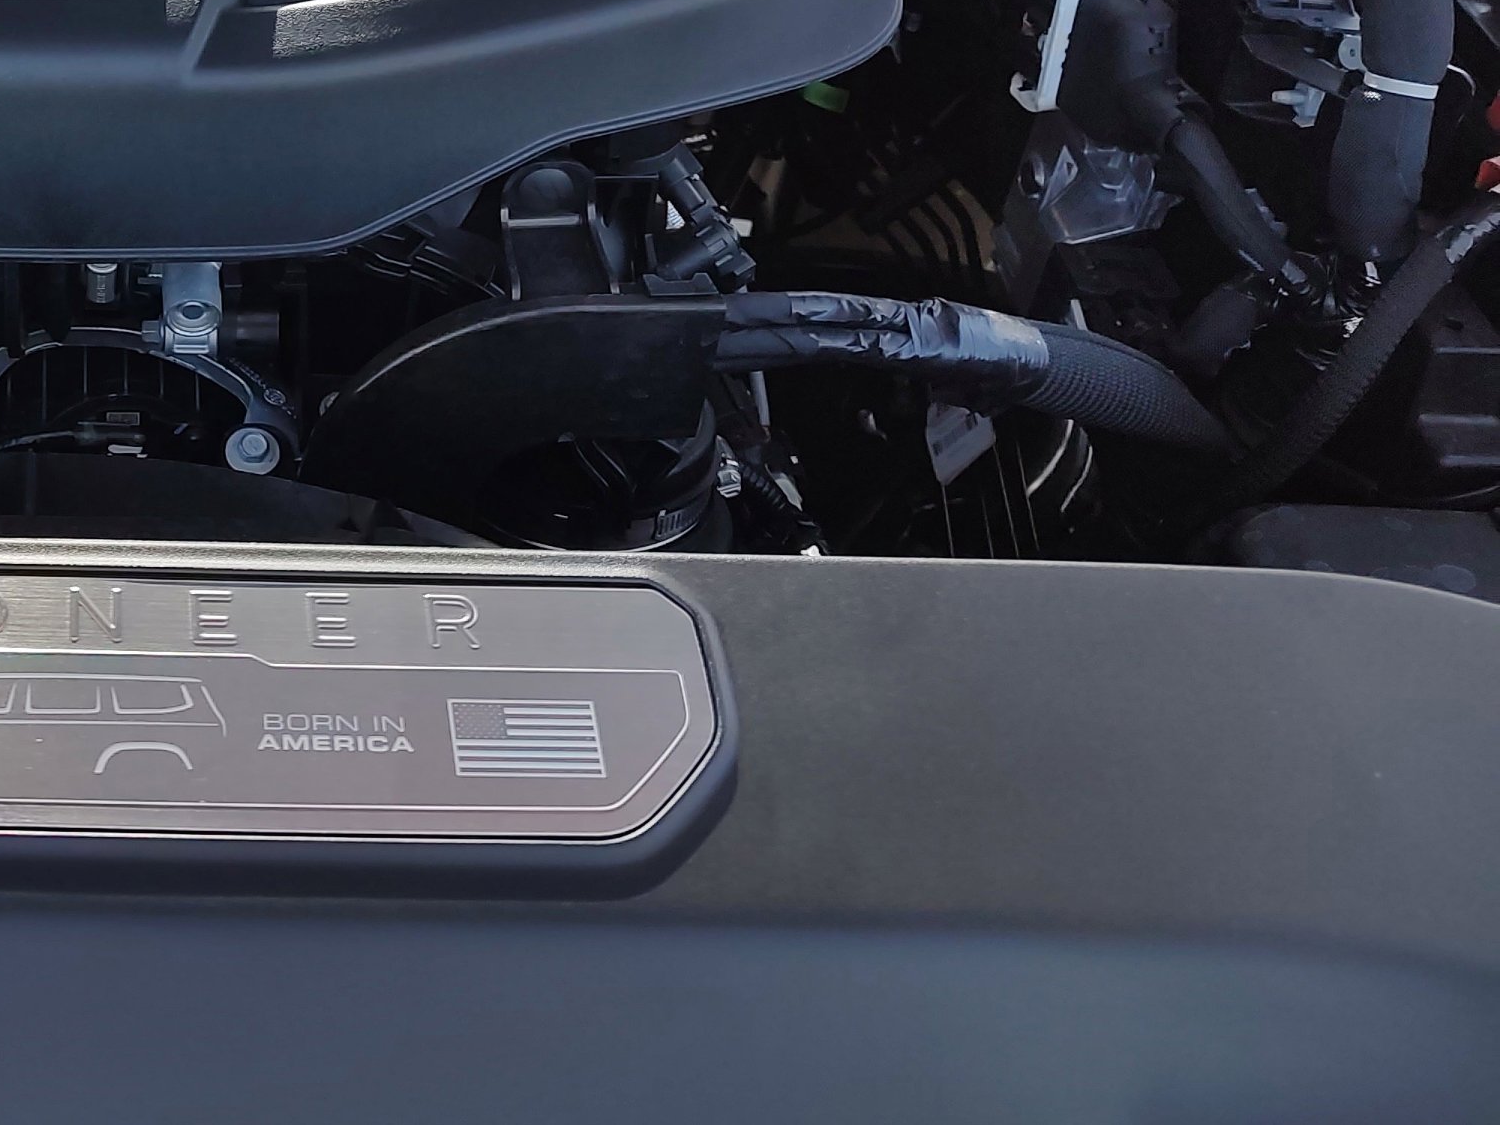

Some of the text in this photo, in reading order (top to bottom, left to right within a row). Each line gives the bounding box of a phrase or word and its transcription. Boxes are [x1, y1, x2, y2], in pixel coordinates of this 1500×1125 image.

[262, 713, 406, 733] BORN IN
[257, 733, 414, 753] AMERICA
